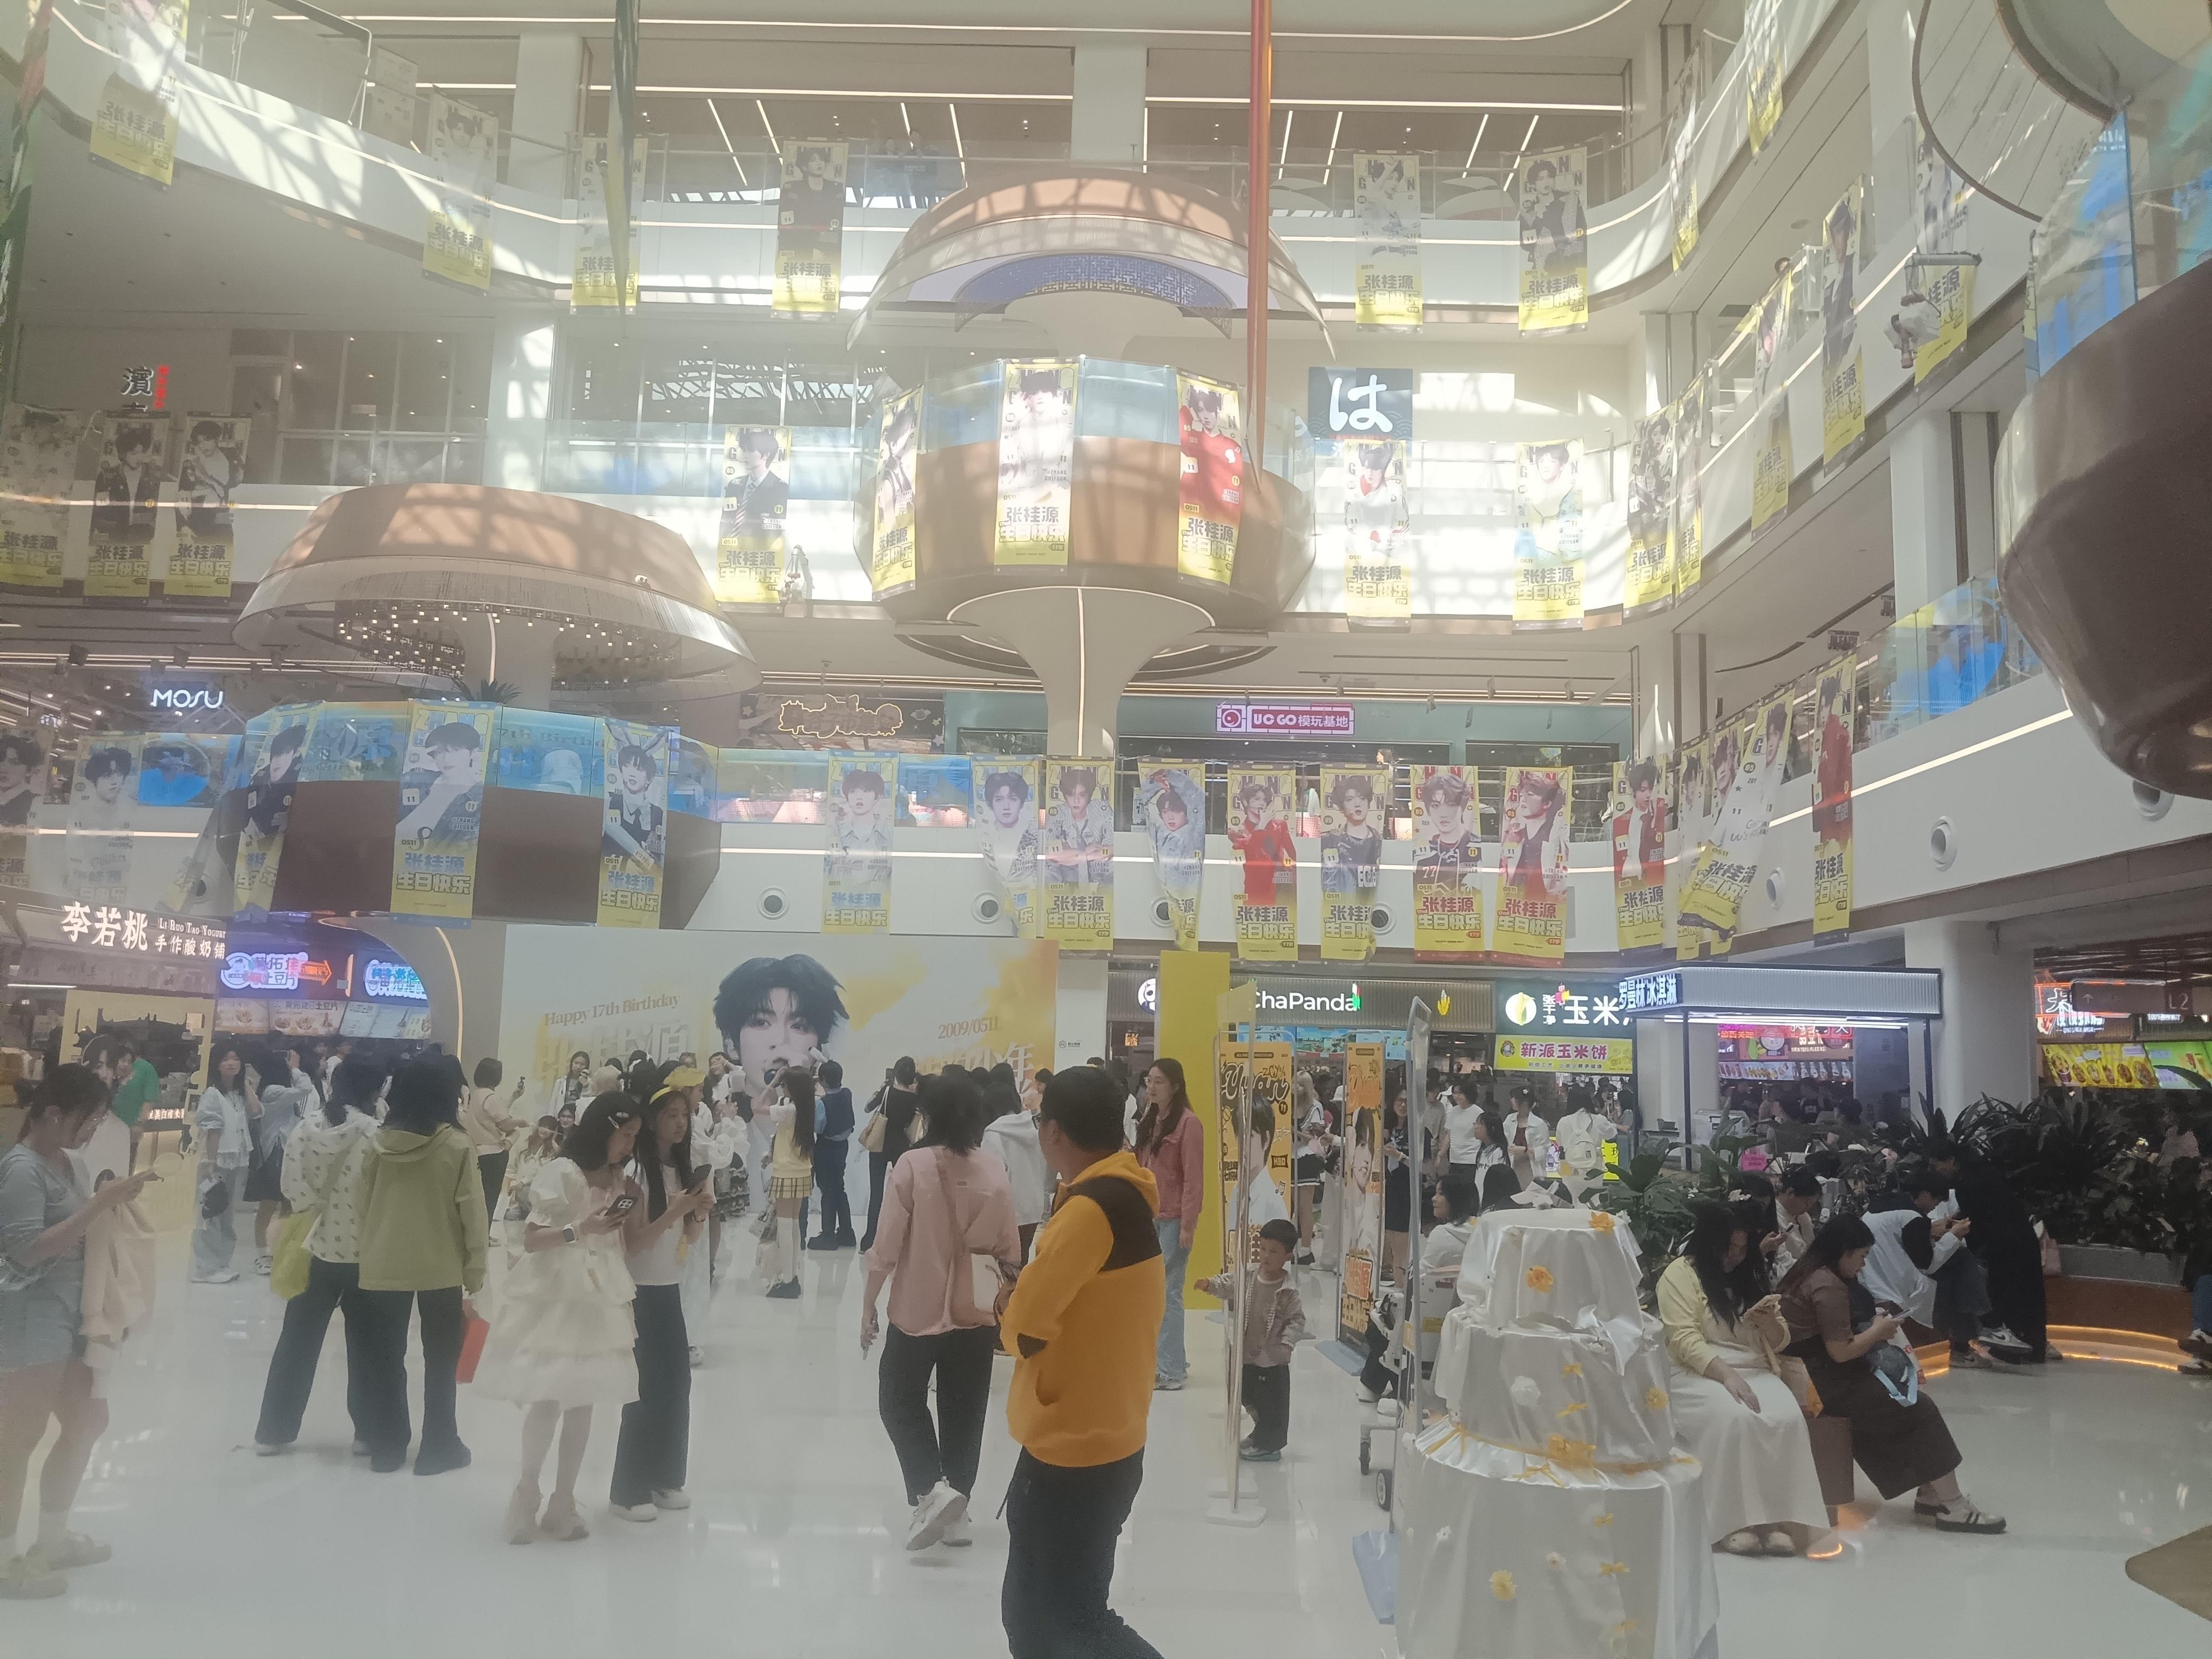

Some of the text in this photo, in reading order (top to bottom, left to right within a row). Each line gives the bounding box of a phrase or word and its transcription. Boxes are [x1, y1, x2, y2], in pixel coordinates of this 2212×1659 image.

[583, 256, 630, 271] 张桂
[784, 262, 832, 277] 张桂源
[1365, 274, 1414, 289] 张桂源
[1529, 274, 1579, 294] 张桂源
[1928, 265, 1960, 302] 桂源
[1329, 374, 1393, 433] は
[1006, 506, 1060, 523] 张桂源
[880, 526, 908, 551] 张桂源
[999, 523, 1066, 542] 生日快乐
[1188, 517, 1234, 543] 张桂源
[96, 544, 144, 560] 张桂源
[178, 543, 226, 560] 张桂源
[1182, 536, 1235, 562] 生日快乐
[1633, 542, 1667, 566] 张桂源
[726, 550, 776, 567] 张桂源
[169, 560, 231, 577] 生日快乐
[719, 567, 781, 583] 生日快乐
[1352, 565, 1402, 581] 张桂源
[1523, 567, 1574, 584] 张桂源
[1347, 582, 1408, 598] 生日快乐
[1516, 582, 1580, 601] 生日快乐
[152, 689, 223, 709] MOSU
[1253, 713, 1296, 726] UC GO
[1298, 714, 1348, 727] 模玩基地
[1745, 764, 1754, 772] 05
[1230, 773, 1292, 795] ZHANG
[404, 852, 466, 874] 张桂源
[1422, 865, 1437, 878] 77
[1815, 853, 1844, 880] 张桂源
[396, 872, 470, 895] 生日快乐
[608, 870, 655, 893] 张桂源
[601, 889, 659, 913] 生日快乐
[831, 892, 882, 909] 张桂源
[1054, 895, 1105, 912] 张桂源
[1422, 896, 1474, 913] 张桂源
[1624, 887, 1664, 908] 张桂源
[824, 909, 888, 926] 生日快乐
[1237, 906, 1289, 922] 张桂源
[1506, 899, 1556, 918] 张桂源
[61, 901, 148, 951] 李若桃
[1047, 912, 1111, 929] 生日快乐
[1417, 913, 1481, 930] 生日快乐
[1497, 917, 1562, 937] 生日快乐
[1239, 922, 1295, 940] 生日快乐
[1325, 922, 1372, 939] 生日快
[155, 934, 226, 960] 手作酸奶铺
[1618, 974, 1677, 1009] 罗曼林冰淇淋
[543, 993, 681, 1028] Happy 17th Birthday
[1563, 995, 1631, 1026] 玉米
[2168, 993, 2189, 1011] L2
[937, 1015, 999, 1040] 2009/0511
[1520, 1042, 1609, 1060] 新派玉米饼
[1279, 1104, 1287, 1113] 11
[1273, 1156, 1286, 1166] HBD
